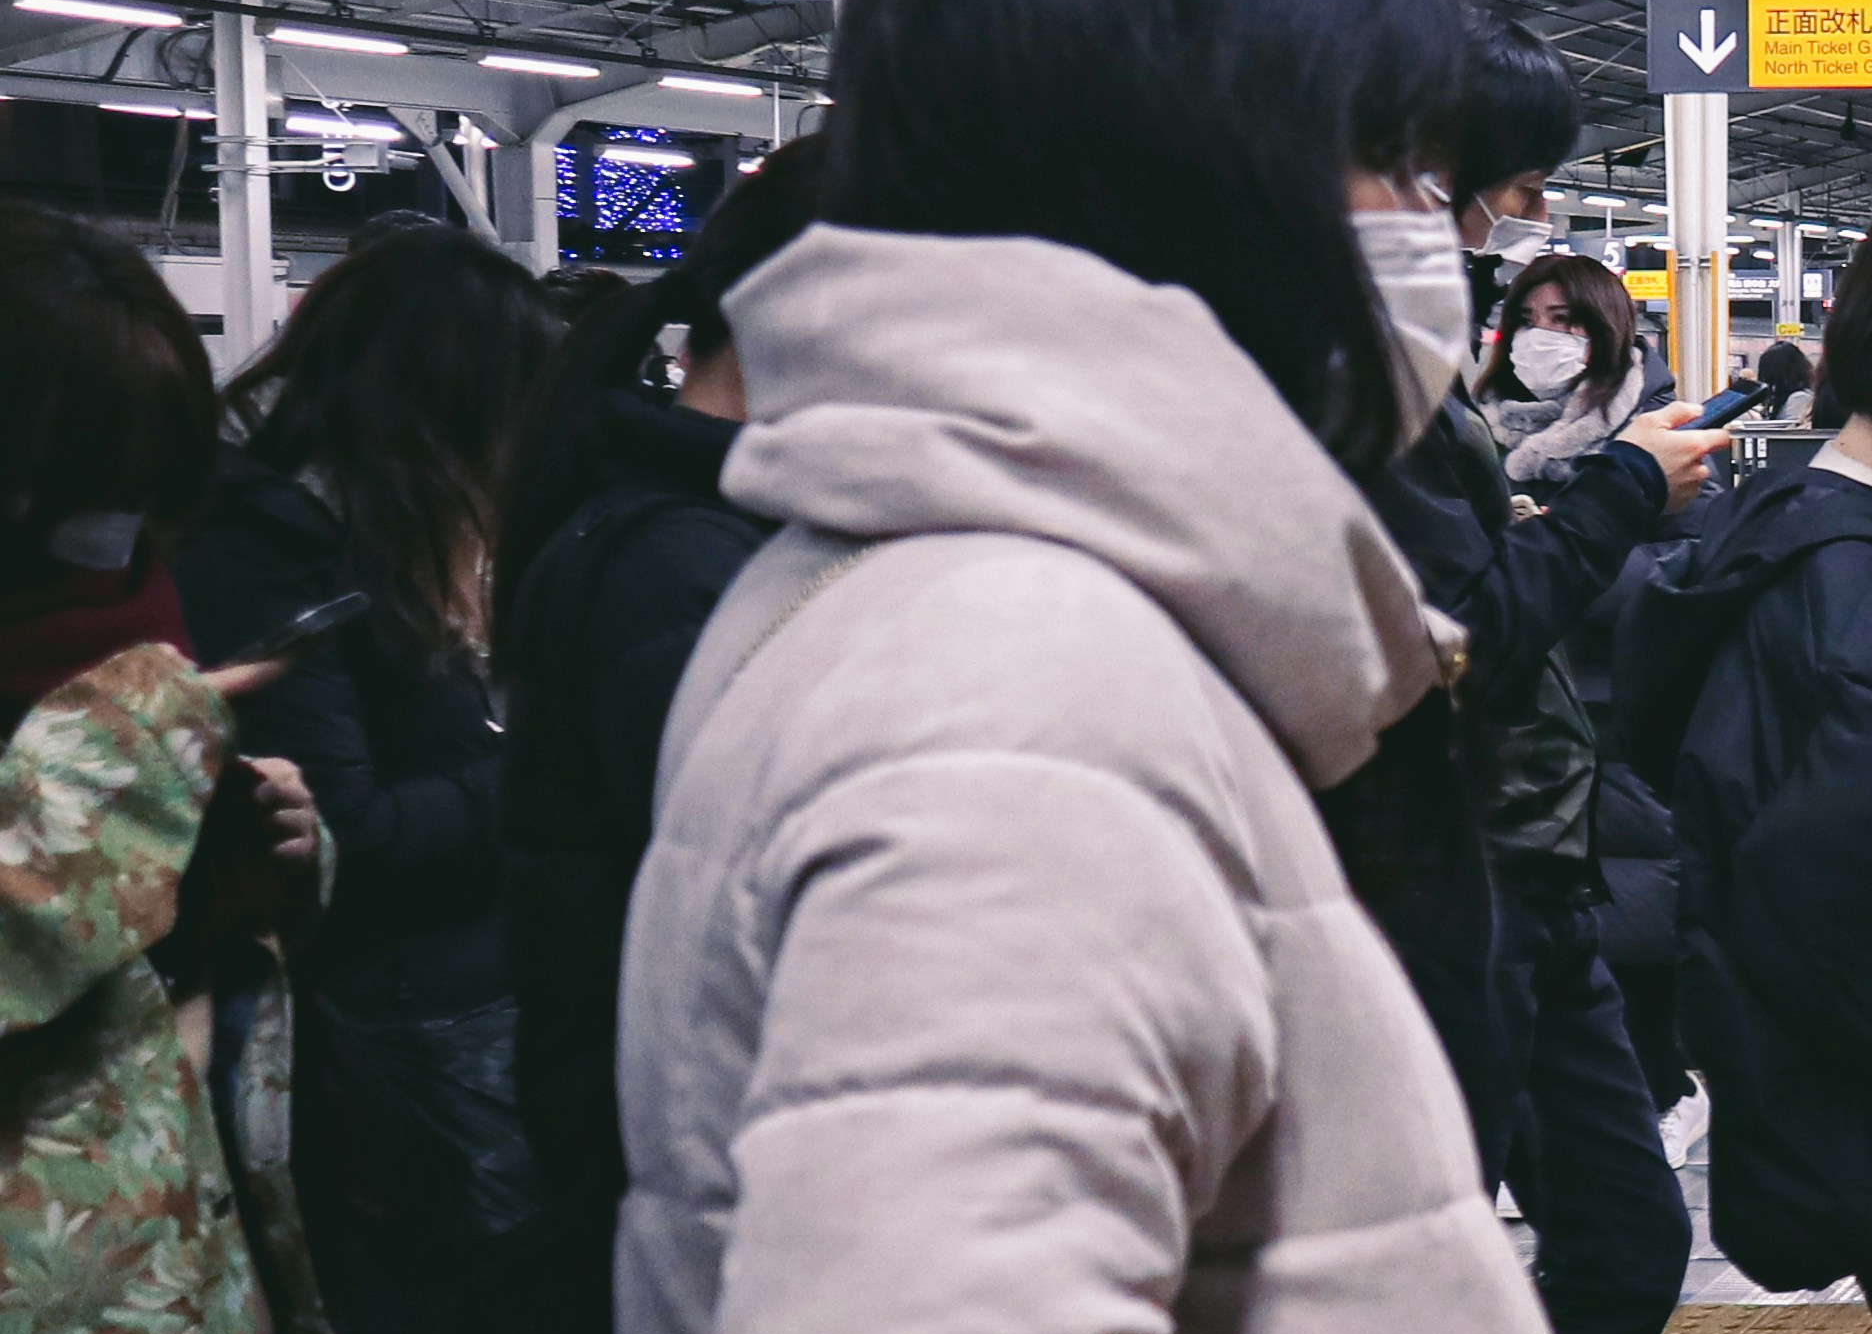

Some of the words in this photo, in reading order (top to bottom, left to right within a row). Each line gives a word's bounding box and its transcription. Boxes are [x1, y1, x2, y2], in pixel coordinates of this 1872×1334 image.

[1765, 40, 1802, 55] Main
[1807, 40, 1853, 55] Ticket
[1765, 60, 1803, 75] North
[1812, 60, 1855, 75] Ticket
[1602, 241, 1620, 267] 5
